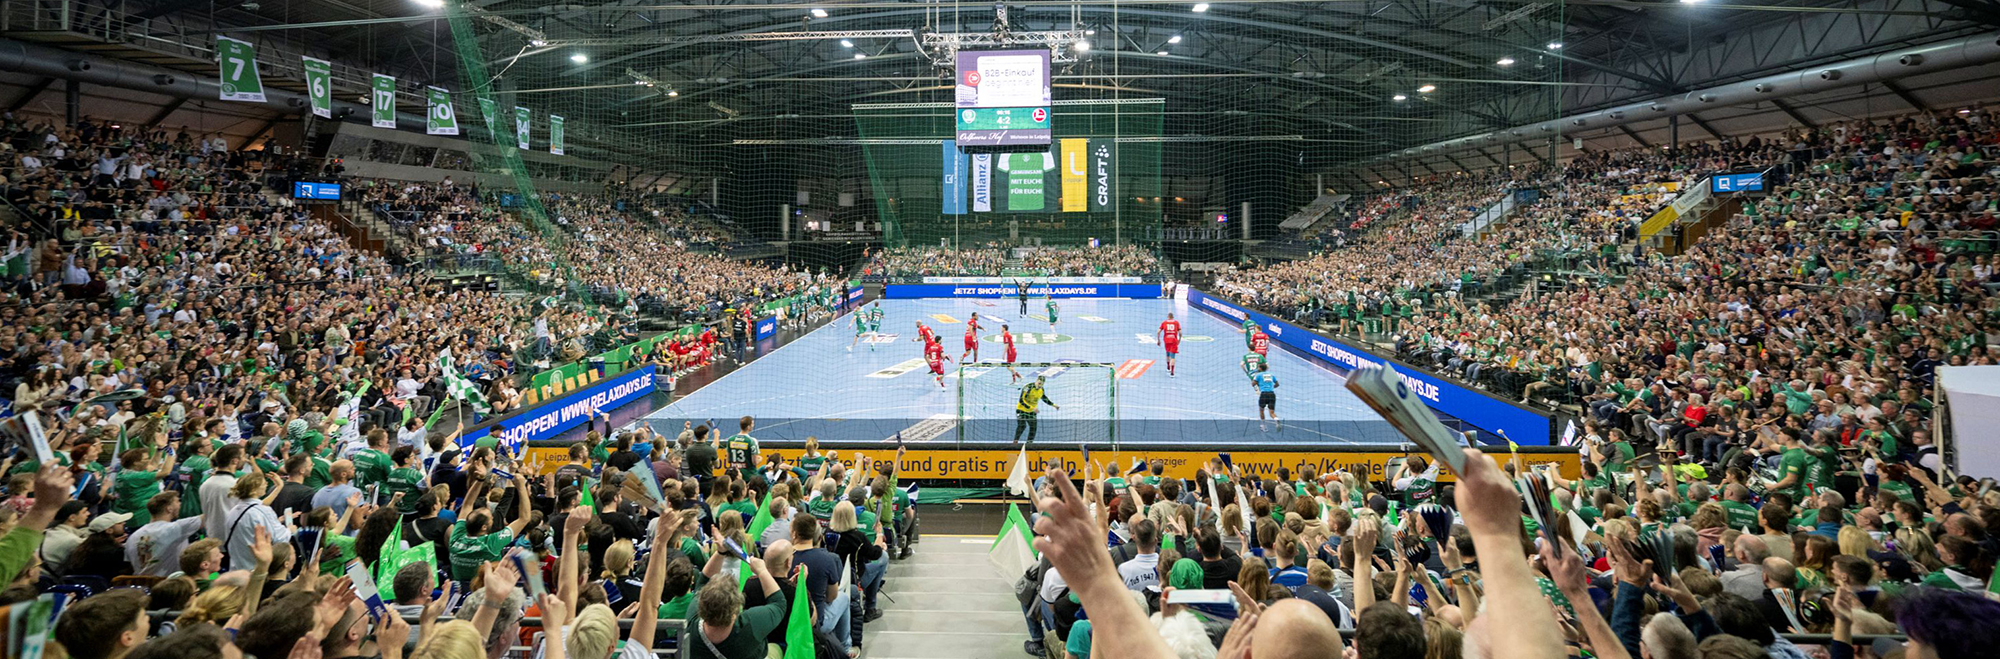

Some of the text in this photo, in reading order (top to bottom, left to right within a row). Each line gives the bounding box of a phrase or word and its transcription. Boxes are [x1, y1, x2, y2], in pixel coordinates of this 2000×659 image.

[228, 57, 245, 81] 7
[984, 68, 1035, 78] B2B-Einkauf
[313, 77, 325, 98] 6
[376, 90, 393, 111] 17
[430, 102, 451, 120] 10
[996, 116, 1011, 125] 4:2
[976, 163, 987, 205] Allianz
[1097, 157, 1109, 206] CRAFT
[953, 287, 976, 295] JETZT
[1166, 323, 1175, 331] 10
[1255, 339, 1266, 348] 73
[1310, 339, 1327, 355] JETZT
[1327, 344, 1357, 367] SHOPPEN!
[731, 449, 746, 463] 13
[900, 457, 932, 472] und
[938, 457, 989, 476] gratis
[1140, 573, 1155, 582] 1947
